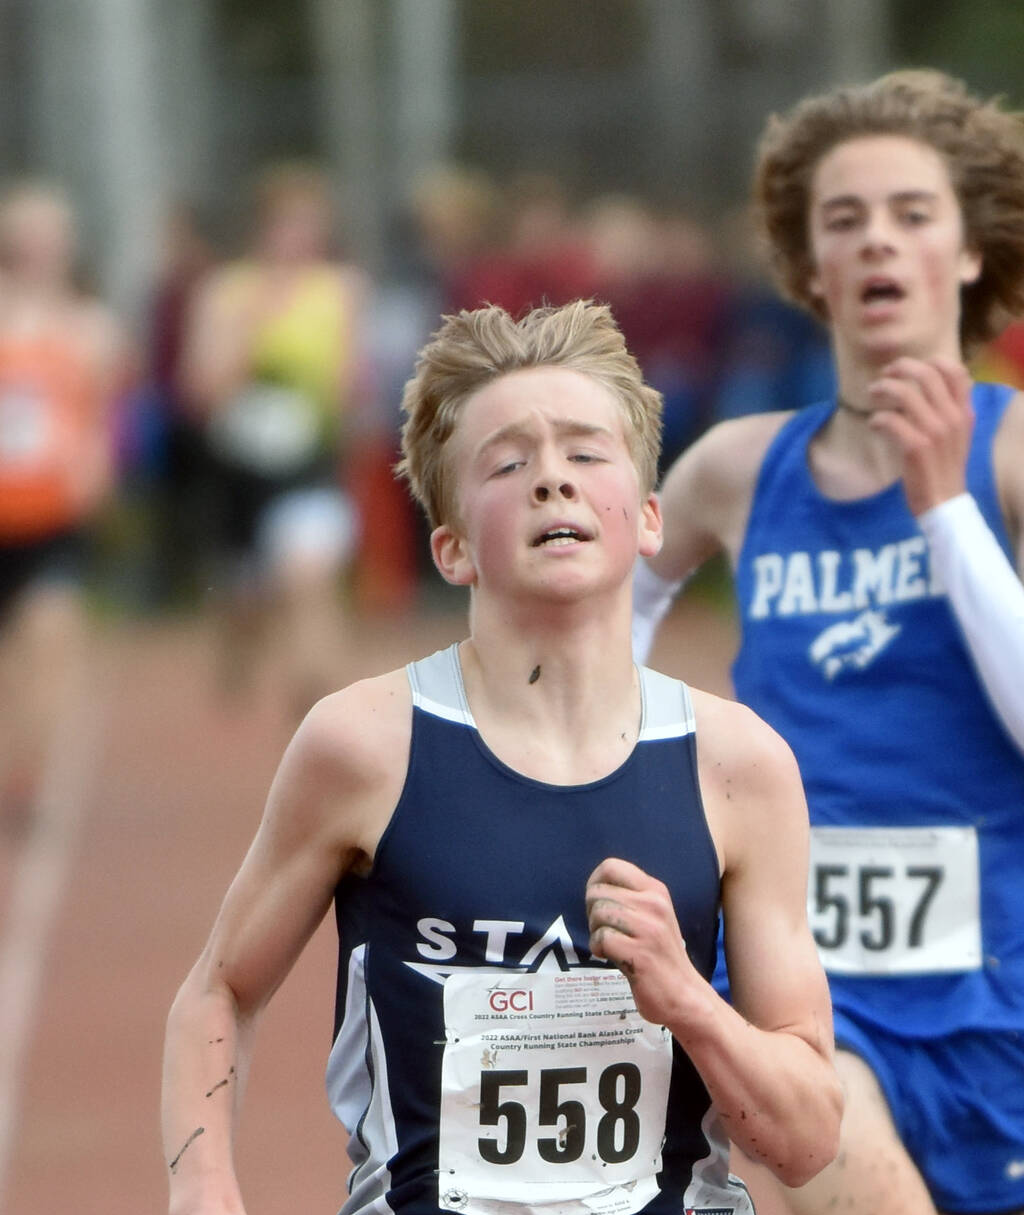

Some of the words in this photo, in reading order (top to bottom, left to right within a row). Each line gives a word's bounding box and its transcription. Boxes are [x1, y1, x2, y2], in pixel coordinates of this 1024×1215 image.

[813, 865, 945, 952] 557
[489, 990, 534, 1012] GCI
[490, 1043, 521, 1052] Country
[524, 1042, 555, 1050] Running
[579, 1037, 636, 1048] Championships
[542, 1032, 576, 1040] National
[598, 1029, 624, 1037] Alaska
[625, 1027, 644, 1035] Cross
[478, 1062, 642, 1165] 558
